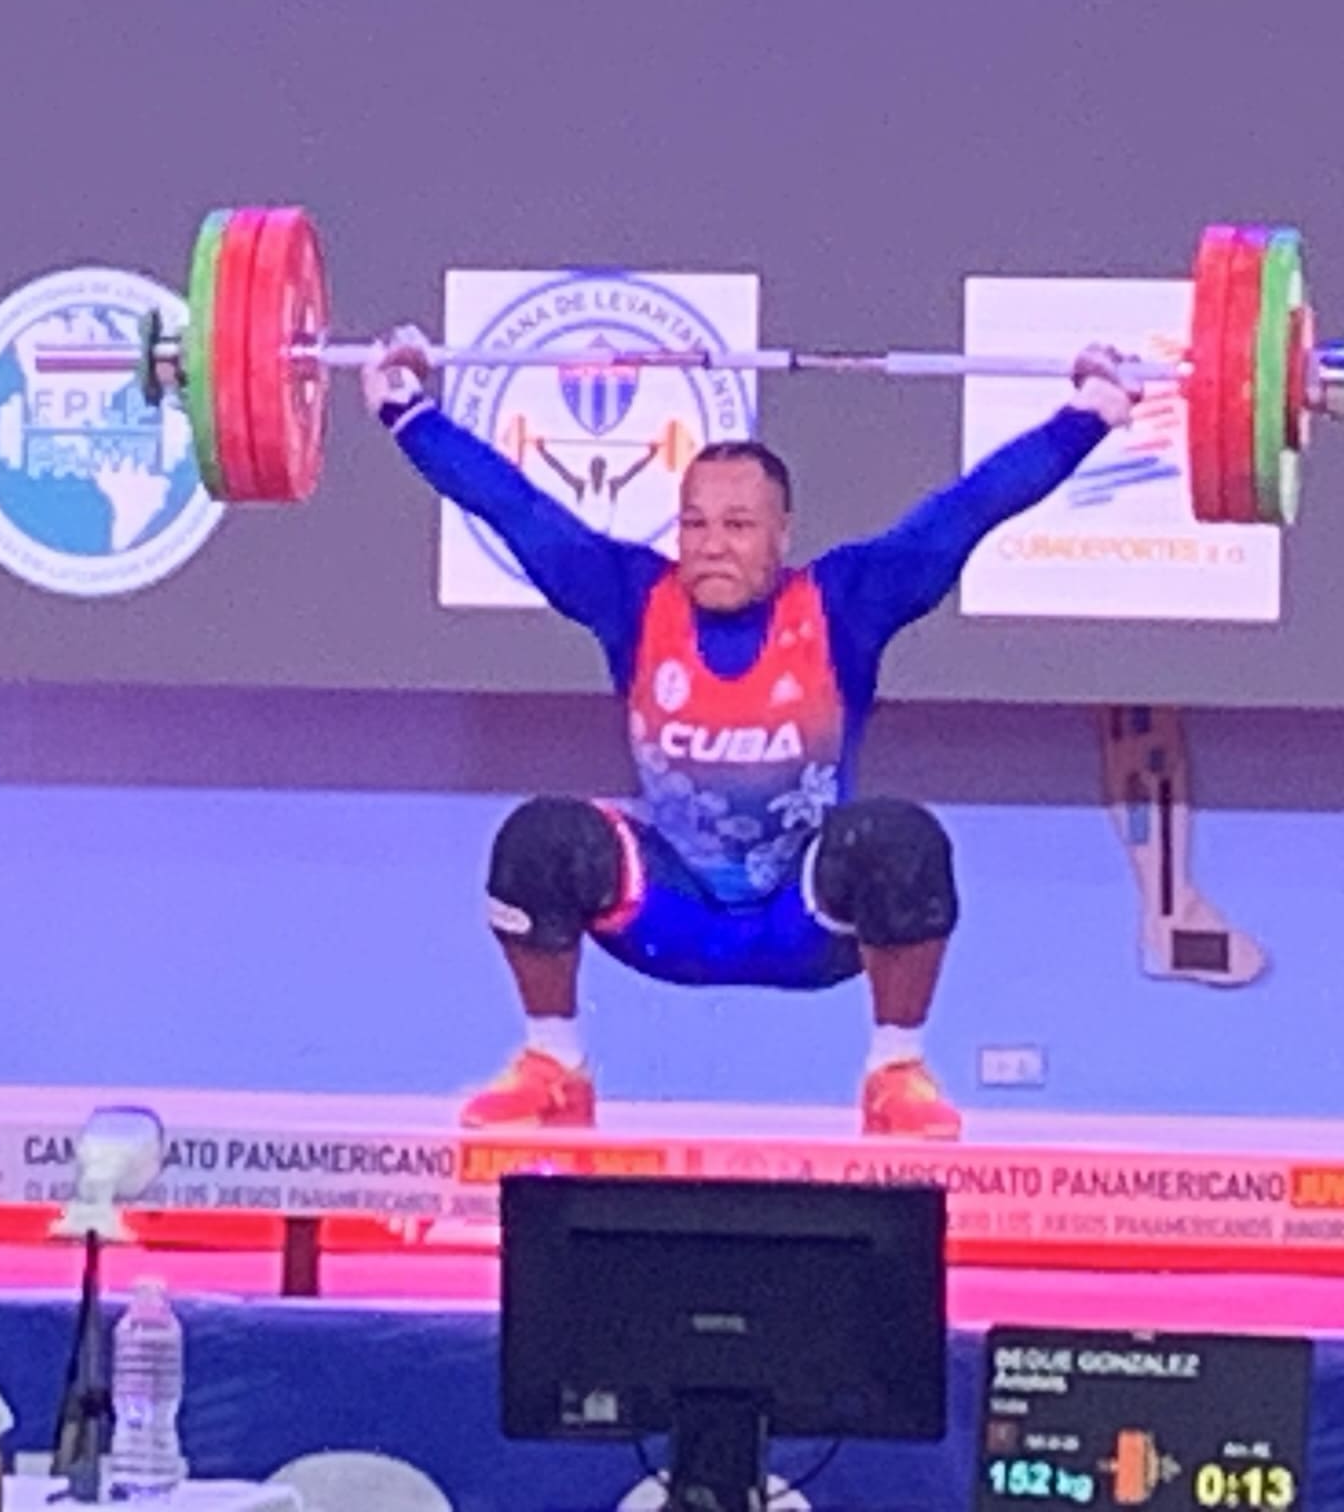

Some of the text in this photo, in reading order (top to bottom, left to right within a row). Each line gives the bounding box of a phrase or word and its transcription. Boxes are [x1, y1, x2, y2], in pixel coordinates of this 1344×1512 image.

[660, 720, 803, 762] CUBA
[227, 1140, 455, 1178] PANAMERICANO
[1052, 1168, 1287, 1203] PANAMERICANO
[990, 1461, 1053, 1496] 152
[1197, 1462, 1296, 1508] 0:13
